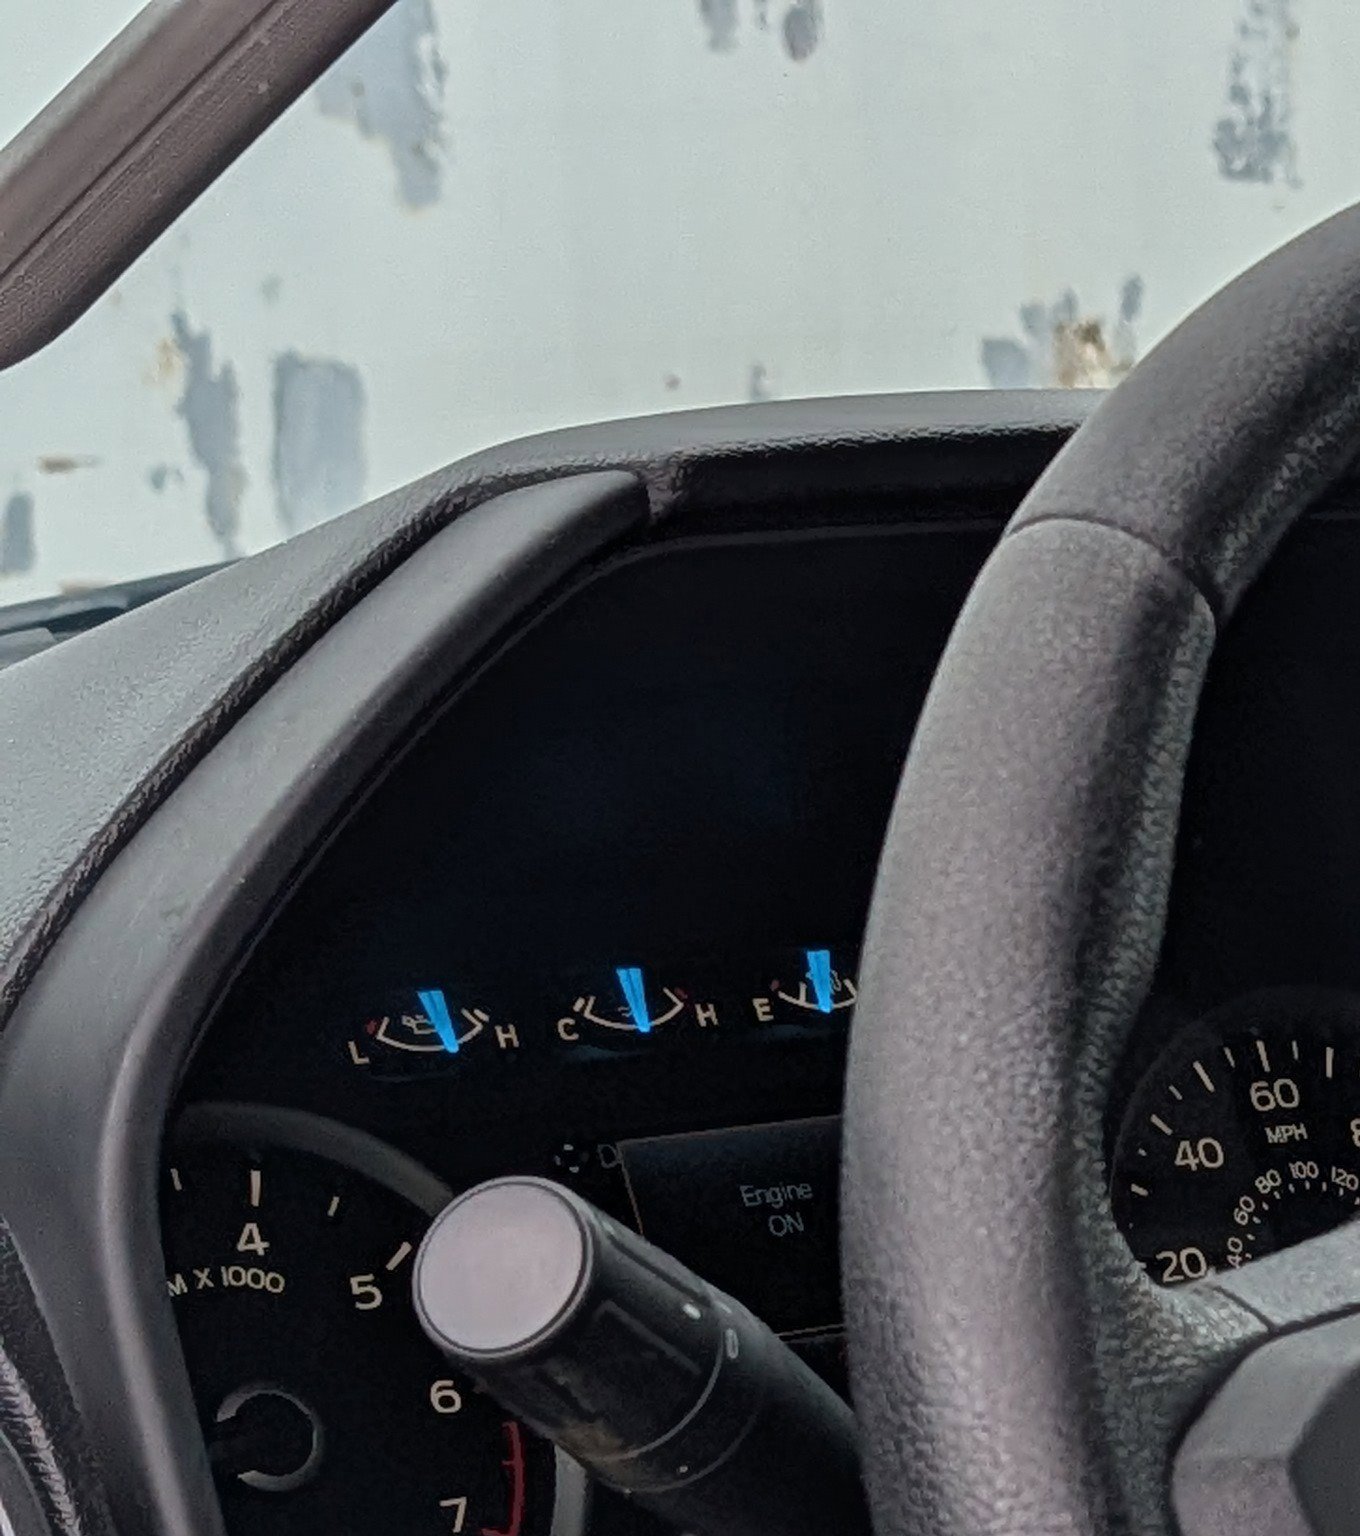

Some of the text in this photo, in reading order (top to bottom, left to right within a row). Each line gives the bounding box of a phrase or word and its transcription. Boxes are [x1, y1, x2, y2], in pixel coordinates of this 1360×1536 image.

[695, 1003, 719, 1027] H
[752, 998, 774, 1021] E
[494, 1023, 520, 1049] H
[557, 1017, 580, 1041] C
[348, 1040, 370, 1065] L
[1250, 1078, 1300, 1112] 60
[1264, 1122, 1309, 1144] MPH
[1174, 1137, 1225, 1171] 40
[1254, 1169, 1282, 1194] 80
[1288, 1160, 1319, 1179] 100
[1331, 1166, 1360, 1191] 120
[740, 1181, 813, 1208] Engine
[1233, 1195, 1256, 1226] 60
[236, 1222, 270, 1256] 4
[768, 1214, 805, 1237] ON
[1156, 1247, 1207, 1283] 20
[1226, 1236, 1243, 1269] 40
[192, 1267, 215, 1290] X
[220, 1265, 286, 1294] 1000
[350, 1273, 383, 1310] 5
[430, 1379, 463, 1414] 6
[439, 1496, 468, 1534] 7
